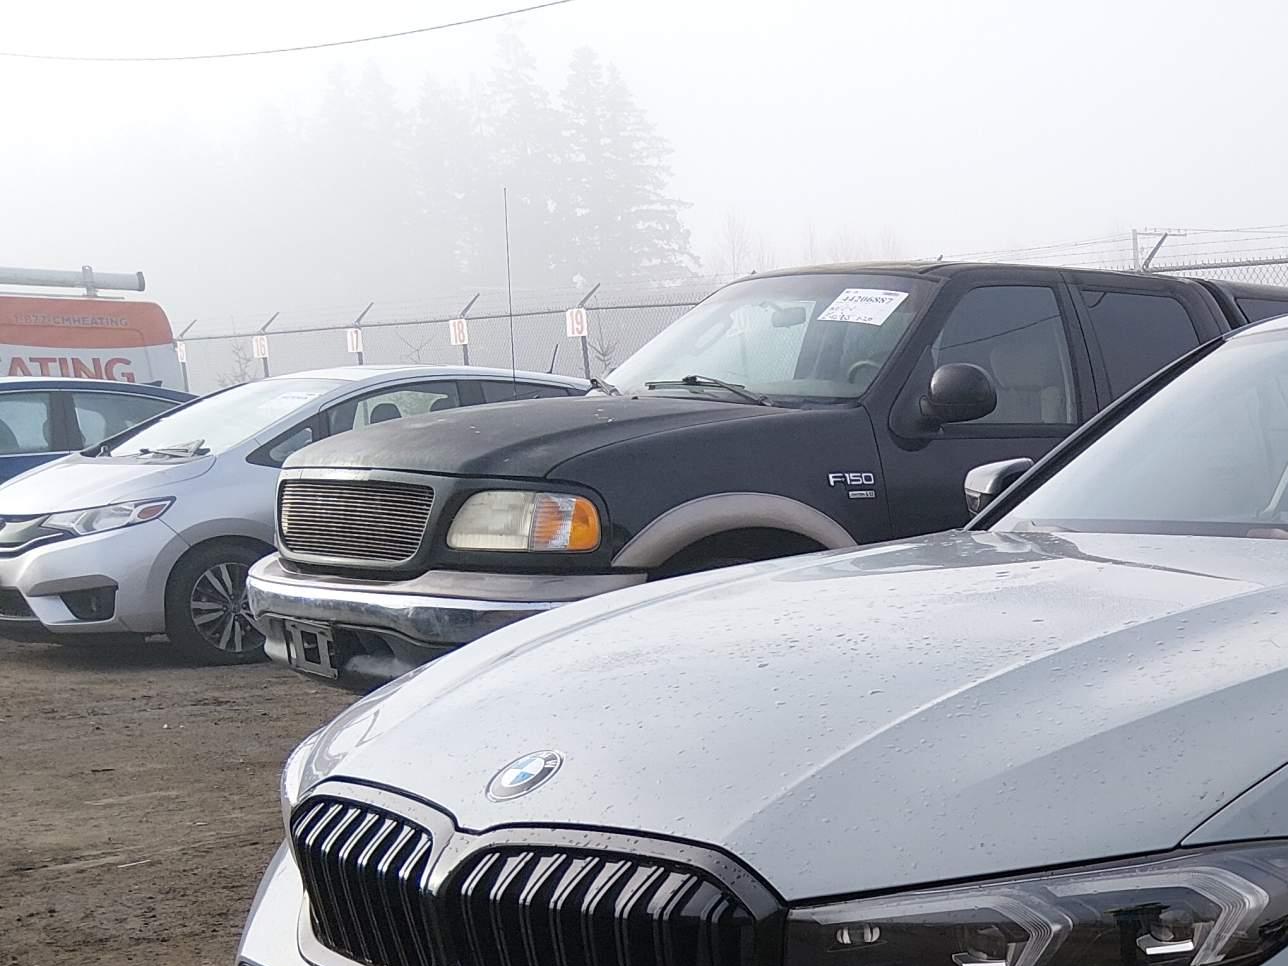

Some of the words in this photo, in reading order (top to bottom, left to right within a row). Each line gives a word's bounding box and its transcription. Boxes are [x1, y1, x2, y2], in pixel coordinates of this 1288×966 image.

[452, 320, 465, 343] 18
[570, 310, 583, 335] 19
[255, 336, 266, 356] 16
[0, 357, 136, 383] ATING
